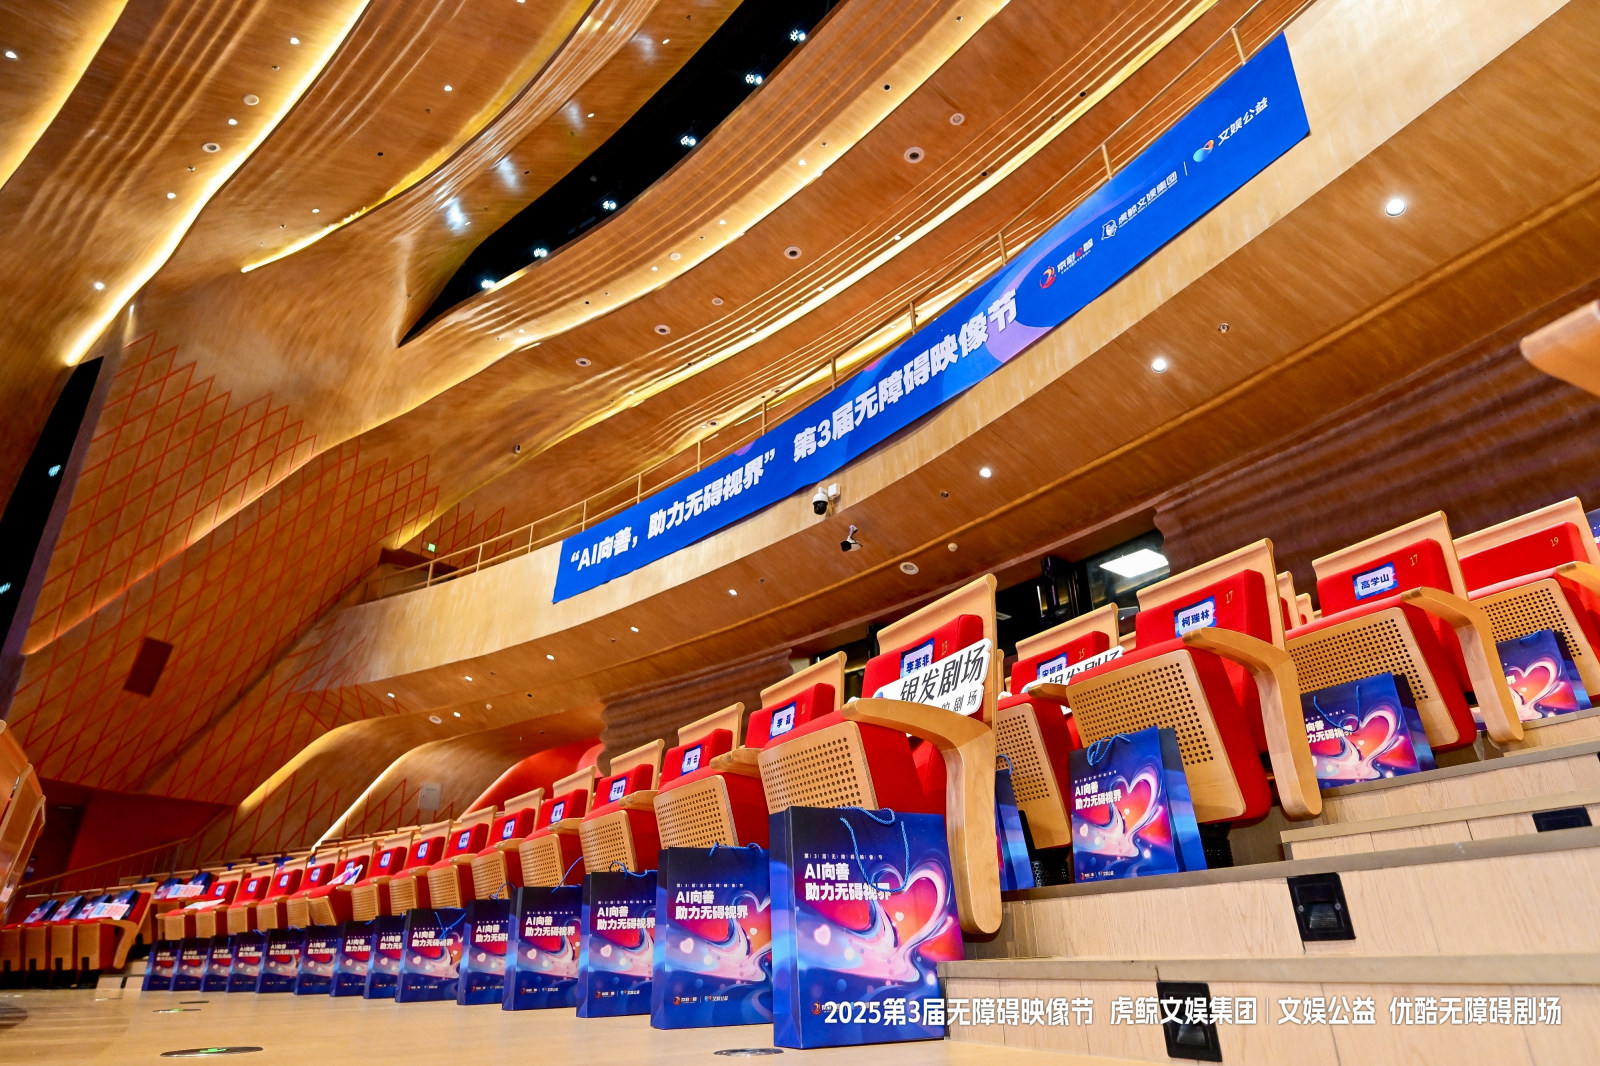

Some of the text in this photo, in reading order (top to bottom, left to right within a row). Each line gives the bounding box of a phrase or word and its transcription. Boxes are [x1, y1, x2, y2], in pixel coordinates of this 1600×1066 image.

[1218, 97, 1268, 146] 文娱公益
[793, 289, 1018, 463] 第3届无障碍映像节
[1550, 536, 1559, 547] 19
[1409, 554, 1418, 566] 17
[1361, 573, 1390, 590] 高学山
[1225, 590, 1233, 604] 17
[900, 644, 986, 704] 银发剧场
[1075, 780, 1099, 797] AI向善
[1075, 788, 1122, 811] 助力无碍视界
[804, 862, 850, 881] AI向善
[675, 890, 715, 904] AI向善
[805, 882, 891, 901] 助力无碍视界
[597, 906, 629, 918] AI向善
[675, 905, 749, 920] 助力无碍视界
[526, 916, 553, 926] AI向善
[596, 917, 656, 931] 助力无碍视界
[475, 924, 501, 933] AI向善
[525, 926, 575, 937] 助力无碍视界
